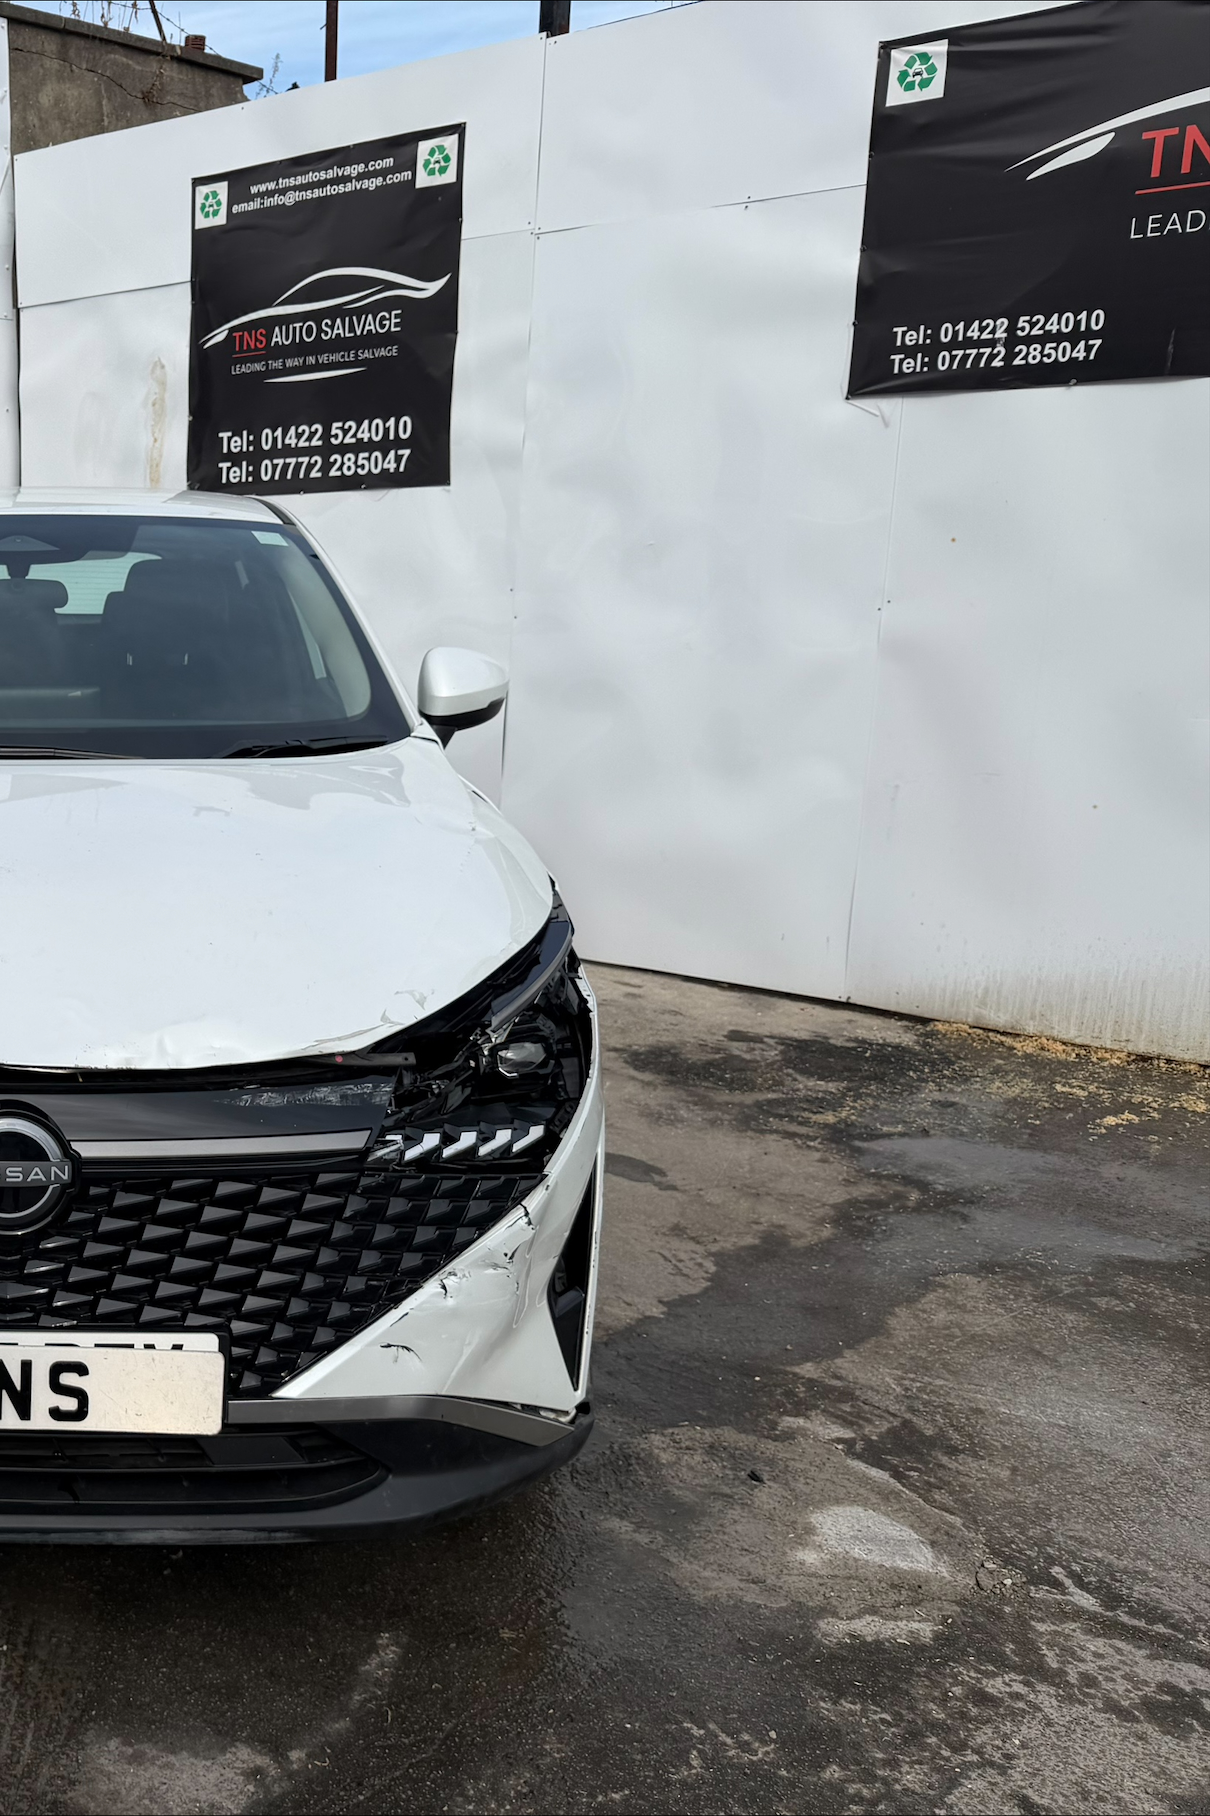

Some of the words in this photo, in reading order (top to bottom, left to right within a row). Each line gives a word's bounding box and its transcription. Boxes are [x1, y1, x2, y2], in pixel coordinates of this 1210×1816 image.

[232, 170, 412, 213] email:info@tnsautosalvage.com
[250, 157, 394, 194] www.tnsautosalvage.com
[232, 328, 267, 351] TNS
[271, 321, 316, 346] AUTO
[321, 309, 402, 340] SALVAGE
[892, 325, 932, 346] Tel:
[940, 318, 1009, 343] 01422
[1016, 309, 1105, 336] 524010
[231, 361, 266, 375] LEADING
[268, 358, 283, 370] THE
[285, 356, 304, 367] WAY
[306, 355, 315, 364] IN
[317, 349, 355, 364] VEHICLE
[357, 345, 398, 359] SALVAGE
[890, 353, 929, 374] Tel:
[937, 347, 1005, 371] 07772
[1012, 339, 1103, 366] 285047
[218, 430, 254, 453] Tel:
[261, 424, 323, 450] 01422
[330, 416, 412, 445] 524010
[218, 461, 254, 484] Tel:
[260, 455, 322, 482] 07772
[328, 449, 411, 477] 285047
